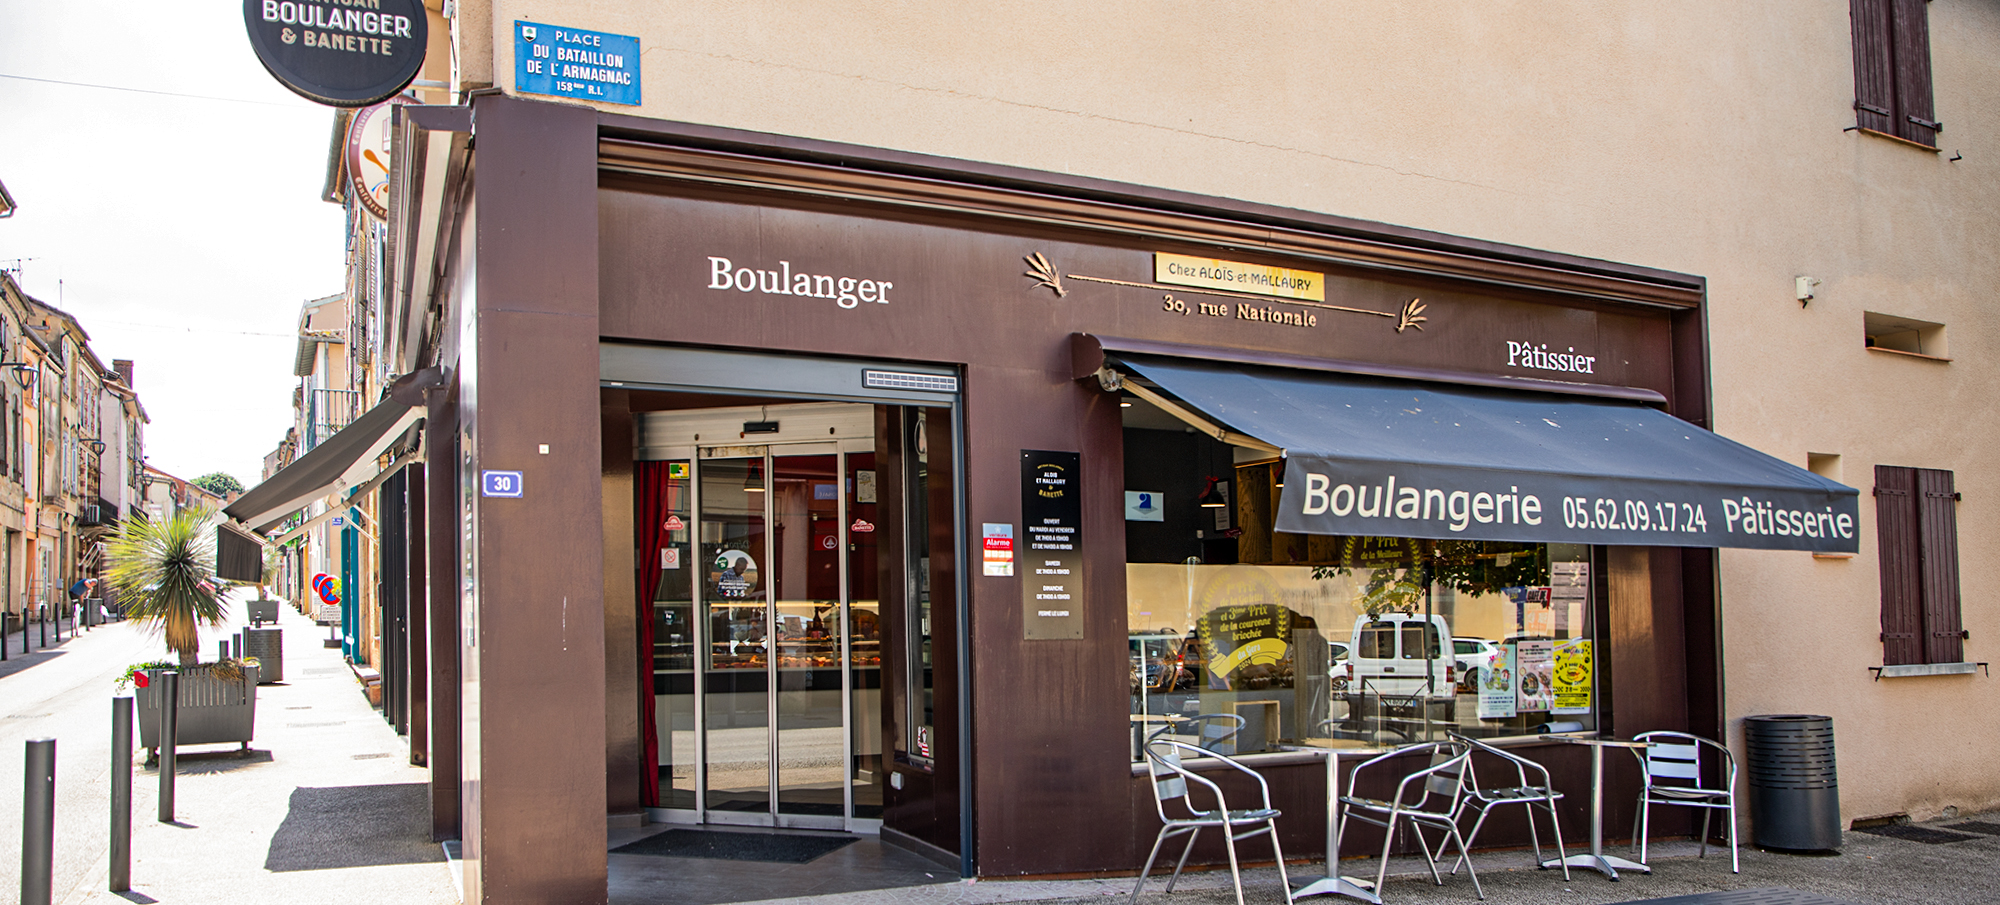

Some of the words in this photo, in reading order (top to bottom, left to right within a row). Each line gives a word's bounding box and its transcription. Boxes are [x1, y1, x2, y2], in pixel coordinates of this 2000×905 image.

[262, 0, 412, 38] BOULANGER
[281, 28, 297, 44] &
[303, 30, 392, 56] BANETTE
[555, 30, 601, 47] PLACE
[533, 43, 550, 58] DU
[557, 47, 623, 68] BATAILLON
[527, 60, 543, 74] DE
[562, 64, 631, 86] ARMAGNAC
[588, 84, 603, 96] R.I.
[707, 256, 893, 309] Boulanger
[1168, 263, 1196, 277] Chez
[1199, 266, 1233, 282] ALOÏS
[1237, 273, 1247, 283] et
[1250, 274, 1312, 291] MALLAURY
[1163, 294, 1191, 316] 30,
[1198, 302, 1228, 316] rue
[1236, 303, 1317, 327] Nationale
[1506, 341, 1596, 374] Pâtissier
[494, 476, 511, 491] 30
[1302, 472, 1543, 532] Boulangerie
[1562, 496, 1707, 533] 05.62.09.17.24
[1722, 496, 1853, 539] Pâtisserie
[1361, 551, 1368, 559] de
[1369, 551, 1375, 559] la
[1248, 604, 1268, 617] Prix
[1220, 623, 1229, 632] de
[1230, 622, 1238, 630] la
[1239, 618, 1271, 629] couronne
[1232, 628, 1262, 641] briochée
[1237, 651, 1247, 660] du
[1246, 644, 1261, 657] Gers
